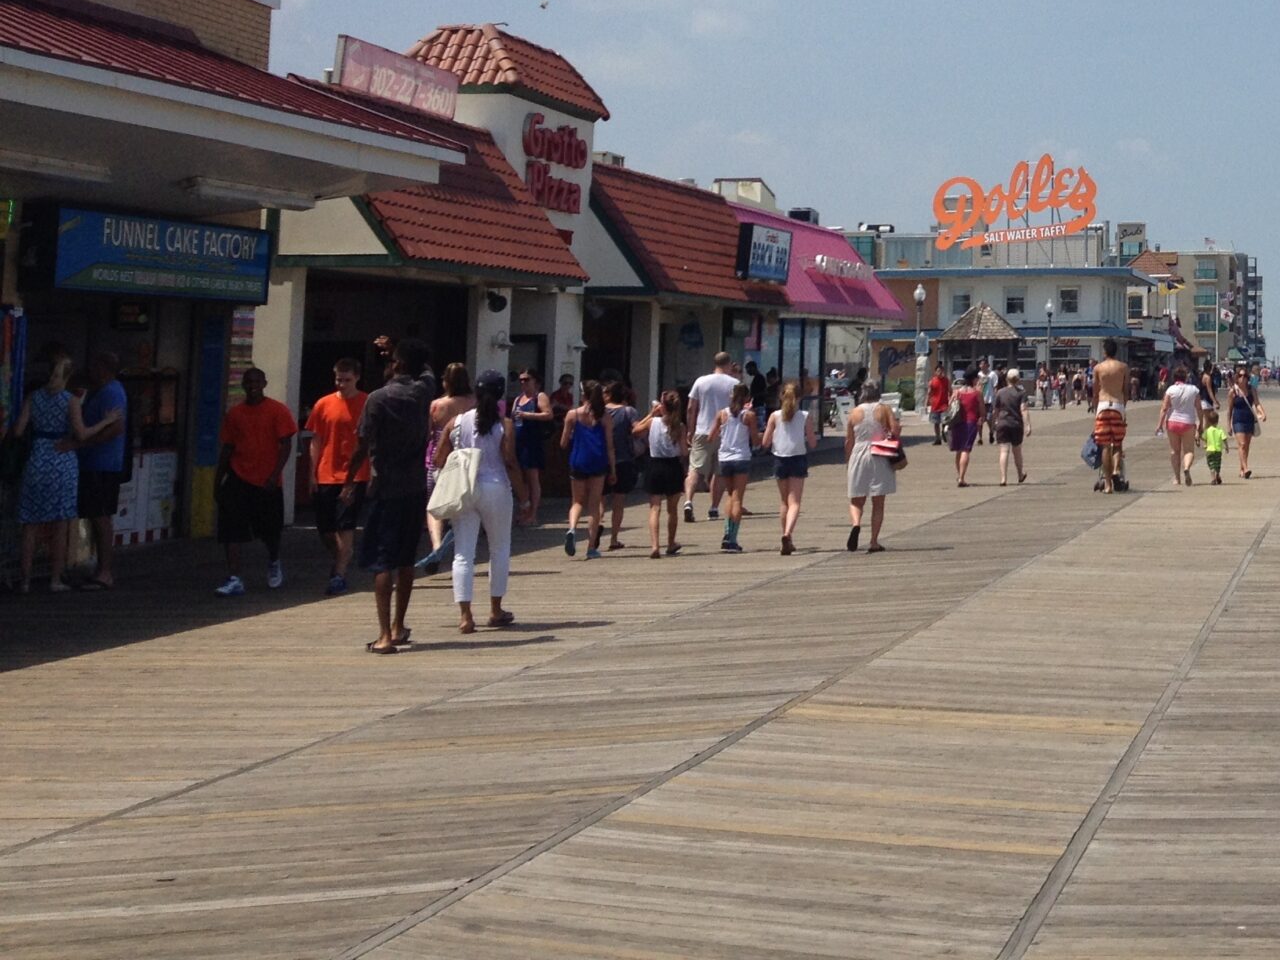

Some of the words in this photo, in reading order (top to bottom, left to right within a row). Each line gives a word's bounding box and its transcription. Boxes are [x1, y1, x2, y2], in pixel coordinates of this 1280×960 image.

[522, 112, 588, 169] Grotto
[526, 161, 581, 214] Pizza
[933, 153, 1098, 250] Dolles
[102, 217, 161, 251] FUNNEL
[164, 226, 200, 254] CAKE
[203, 230, 258, 261] FACTORY
[983, 231, 1005, 244] SALT
[1006, 228, 1037, 242] WATER
[1039, 224, 1067, 239] TAFFY
